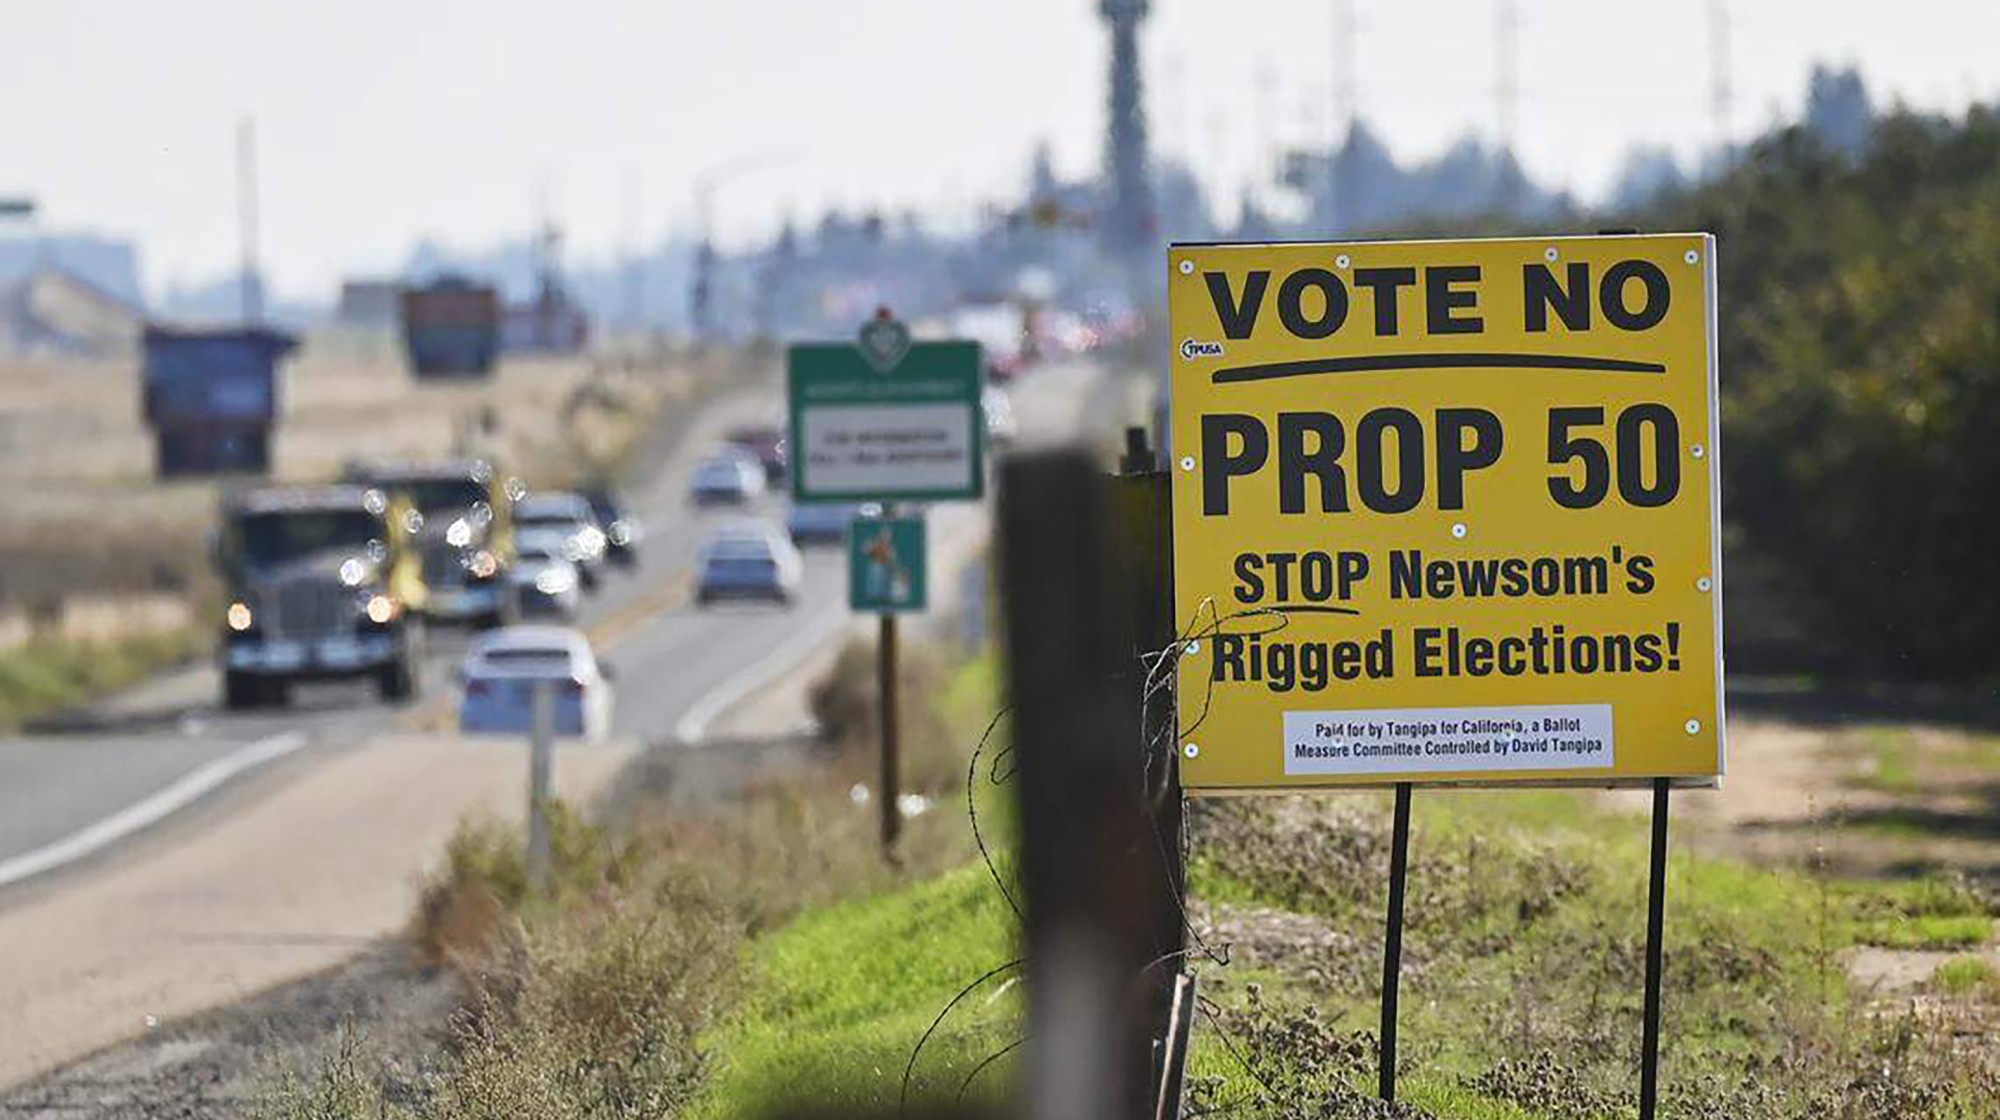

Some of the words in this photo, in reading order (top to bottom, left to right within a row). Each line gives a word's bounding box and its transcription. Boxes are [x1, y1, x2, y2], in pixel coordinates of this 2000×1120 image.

[1203, 265, 1484, 340] VOTE
[1522, 258, 1672, 333] NO
[1186, 343, 1222, 355] TPUSA
[1201, 407, 1503, 517] PROP
[1546, 403, 1680, 510] 50
[1233, 551, 1369, 605] STOP
[1389, 545, 1656, 599] Newsom's
[1213, 628, 1394, 693] Rigged
[1414, 622, 1680, 678] Elections!
[1295, 743, 1349, 758] Measure
[1353, 742, 1421, 757] Committee
[1425, 739, 1490, 755] Controlled
[1494, 739, 1509, 756] by
[1512, 738, 1548, 753] David
[1551, 737, 1602, 755] Tangipa
[1315, 723, 1344, 737] Paid
[1347, 723, 1364, 737] for
[1368, 723, 1383, 739] by
[1387, 722, 1437, 738] Tangipa
[1441, 721, 1458, 735] for
[1462, 719, 1528, 734] California,
[1531, 721, 1540, 732] a
[1543, 718, 1581, 732] Ballot
